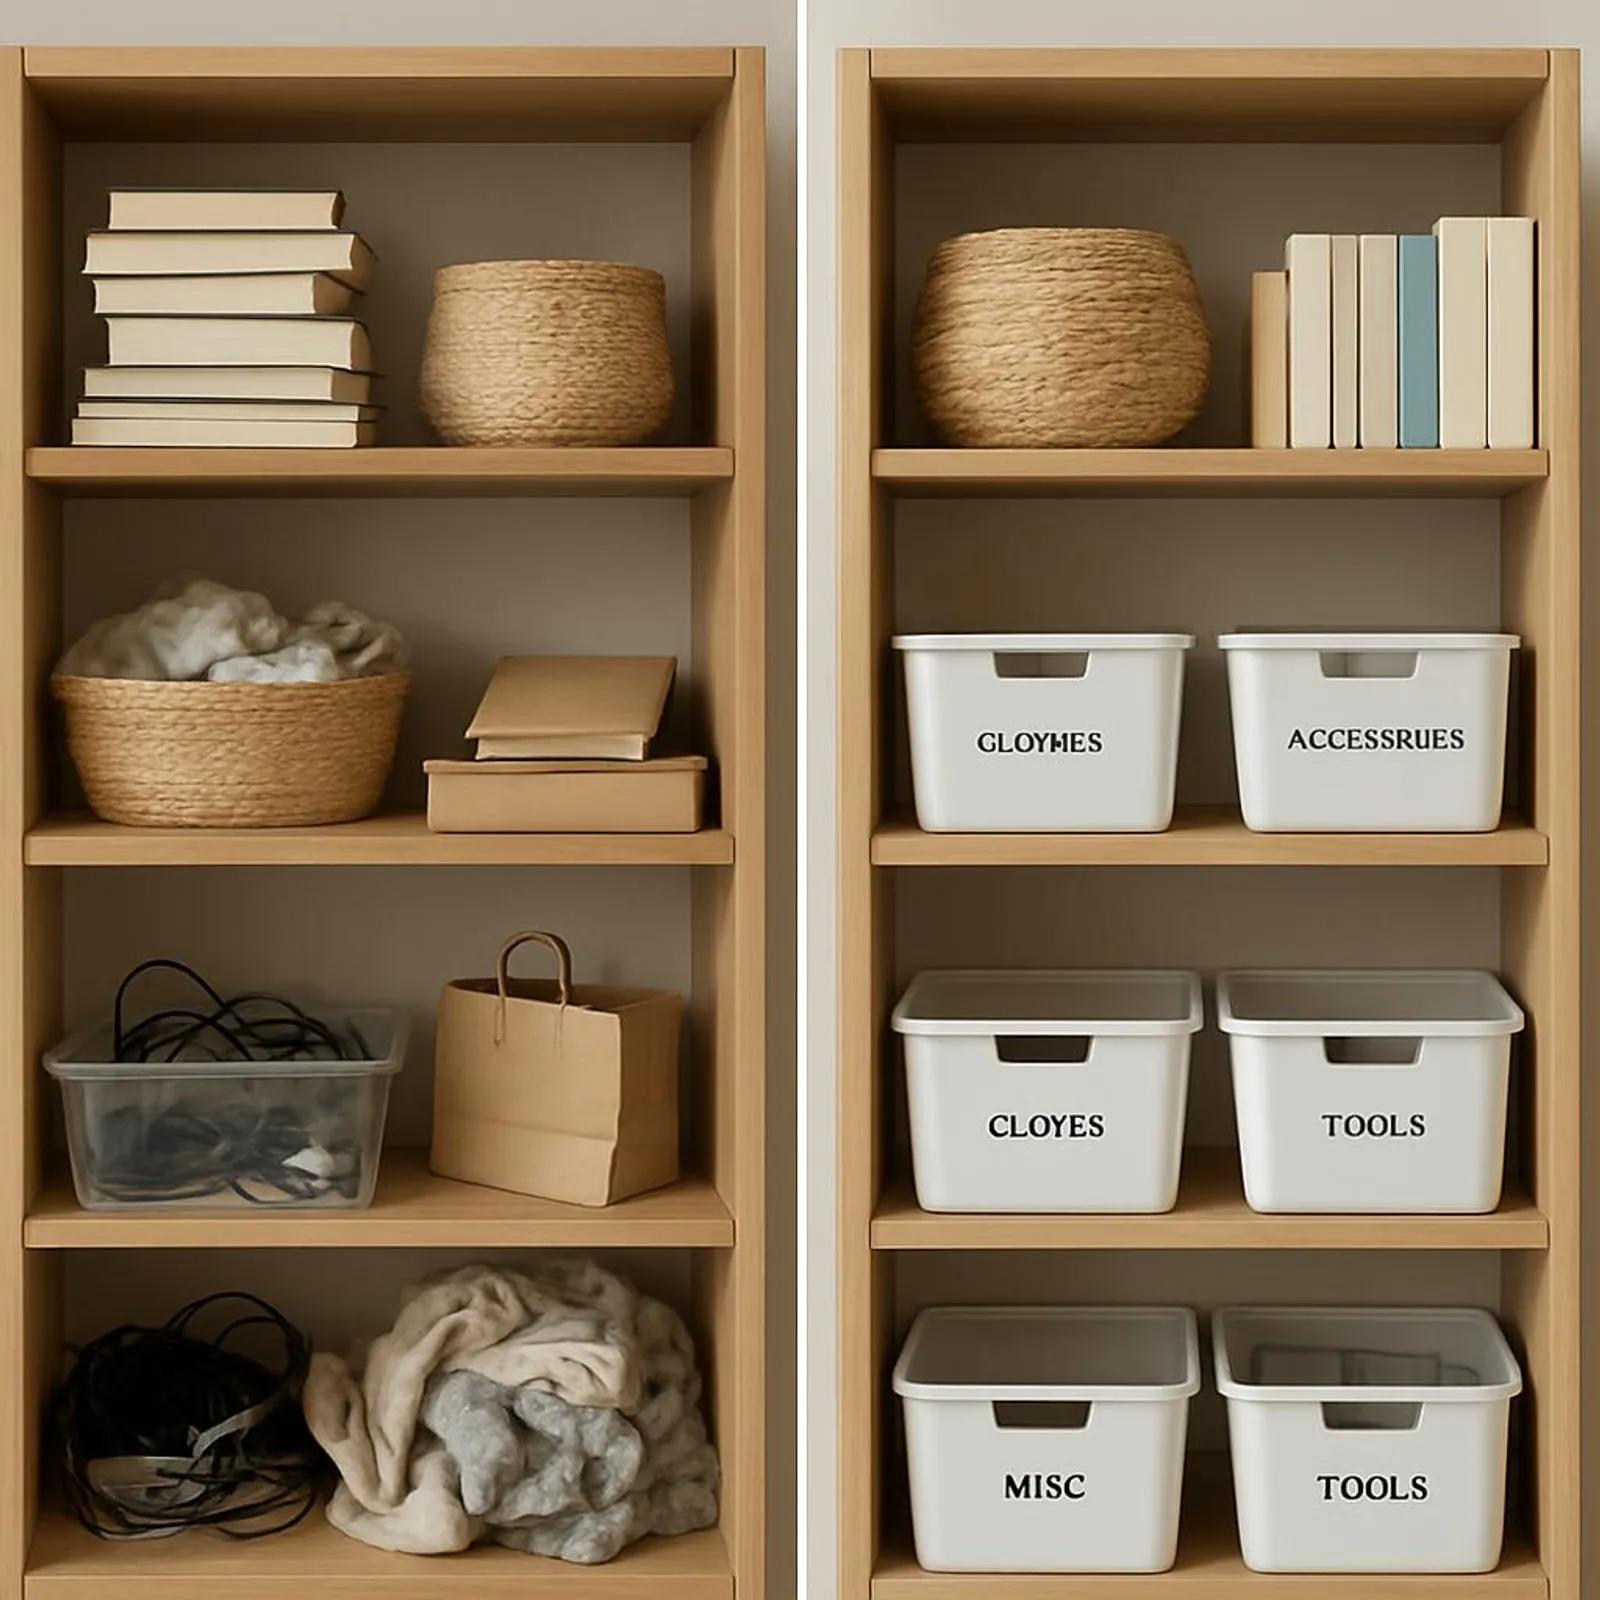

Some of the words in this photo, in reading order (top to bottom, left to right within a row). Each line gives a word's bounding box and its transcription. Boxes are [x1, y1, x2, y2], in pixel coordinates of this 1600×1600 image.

[1287, 728, 1465, 750] ACCESSRUES
[988, 1114, 1105, 1138] CLOYES
[1321, 1114, 1426, 1138] TOOLS
[1004, 1474, 1086, 1500] MISC
[1316, 1475, 1428, 1501] TOOLS
